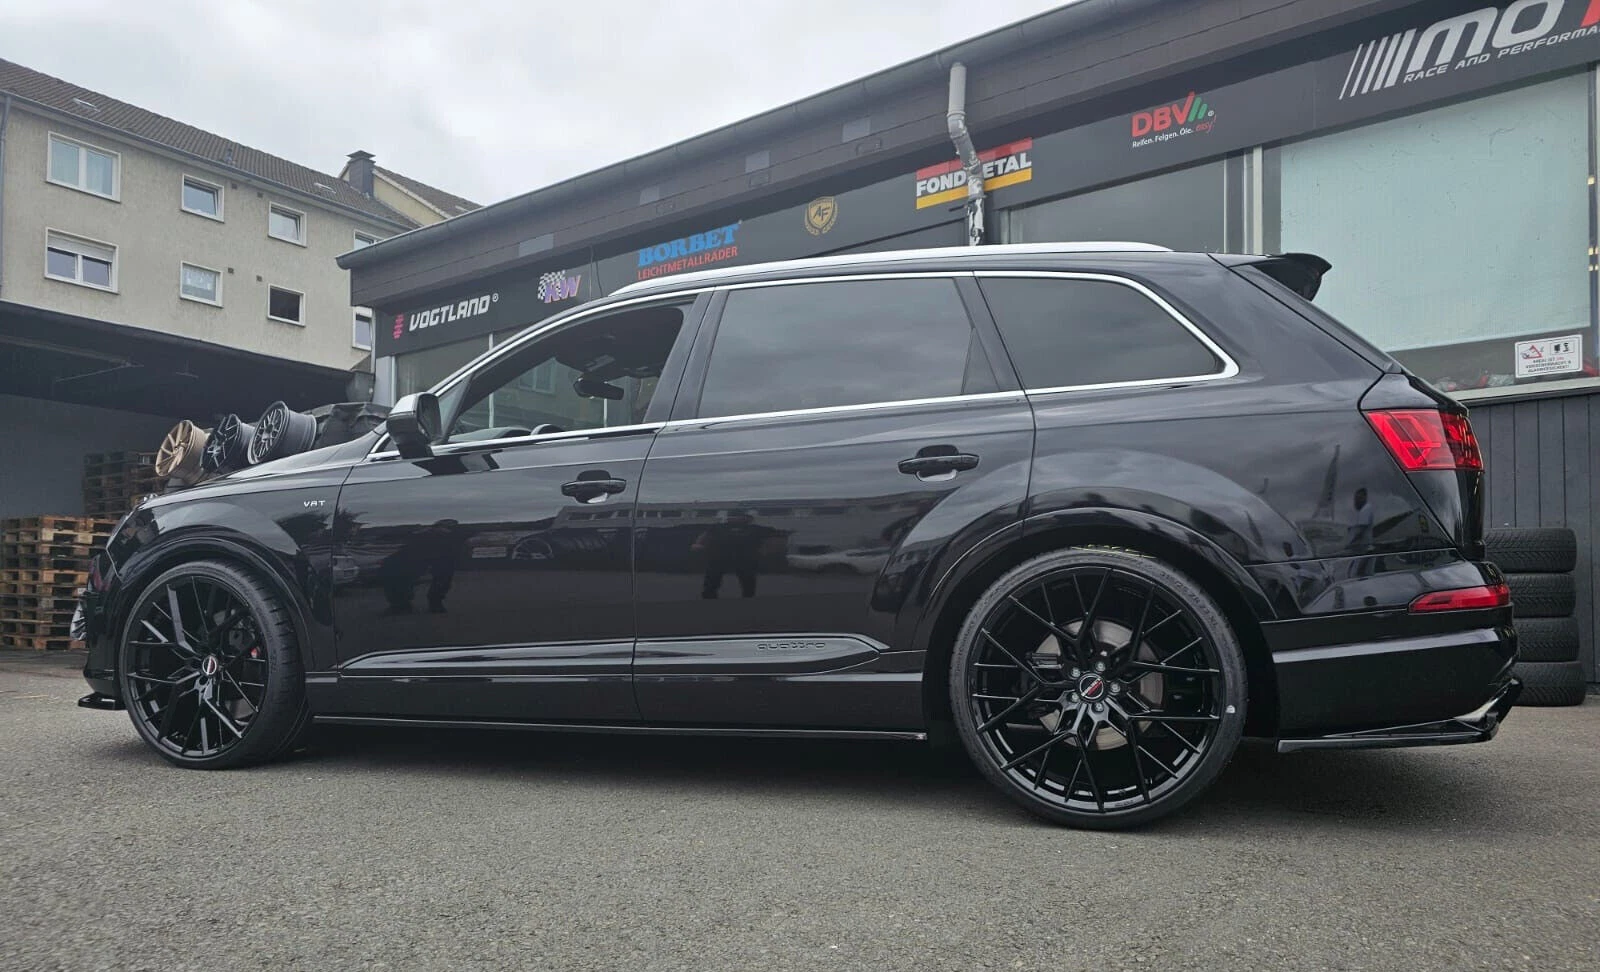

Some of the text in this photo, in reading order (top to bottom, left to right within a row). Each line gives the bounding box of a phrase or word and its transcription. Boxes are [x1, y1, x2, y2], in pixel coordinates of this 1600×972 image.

[1403, 25, 1600, 83] RACE AND PERFORMA
[1154, 132, 1179, 144] Felgen.
[916, 152, 1032, 197] FONDETAL
[637, 223, 739, 267] BORBET
[543, 275, 581, 303] KW
